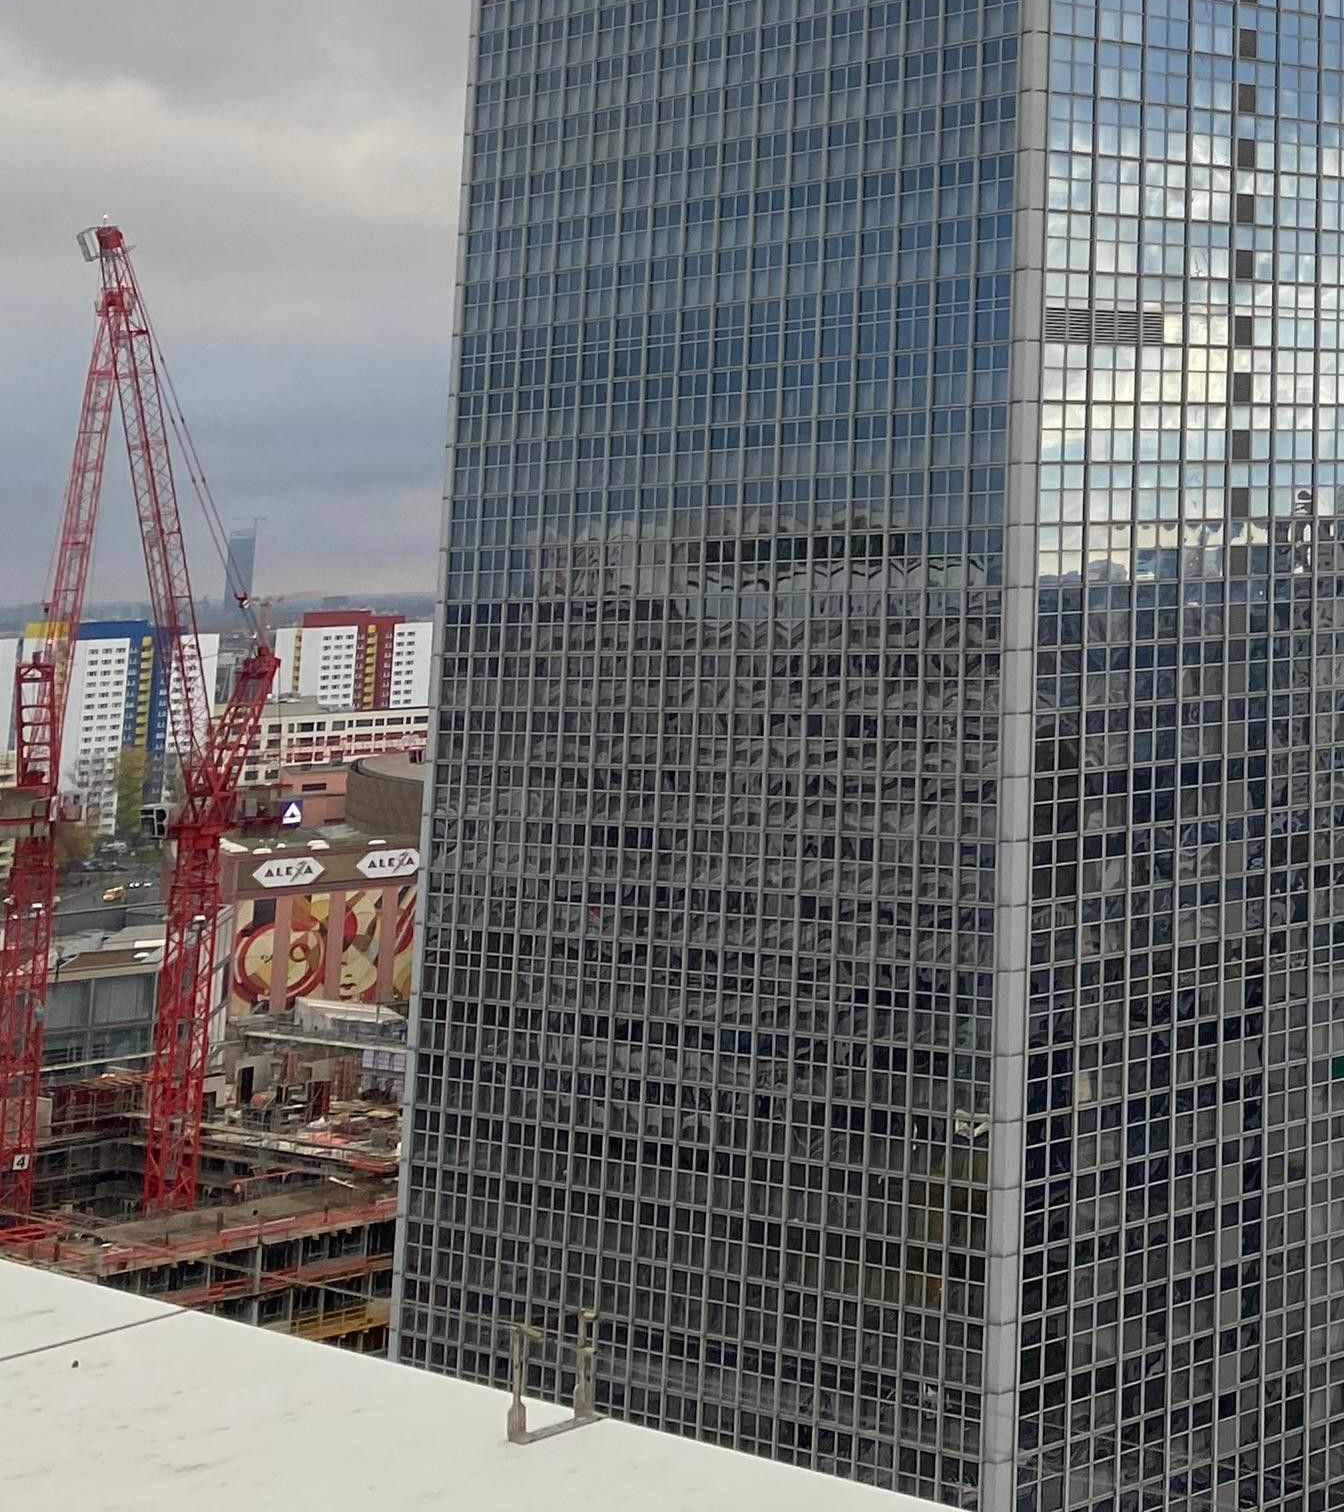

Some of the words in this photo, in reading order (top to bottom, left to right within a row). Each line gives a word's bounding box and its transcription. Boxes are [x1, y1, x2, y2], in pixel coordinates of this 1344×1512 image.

[264, 860, 314, 882] ALEXA
[367, 851, 415, 874] ALEXA
[16, 1155, 26, 1169] 4
